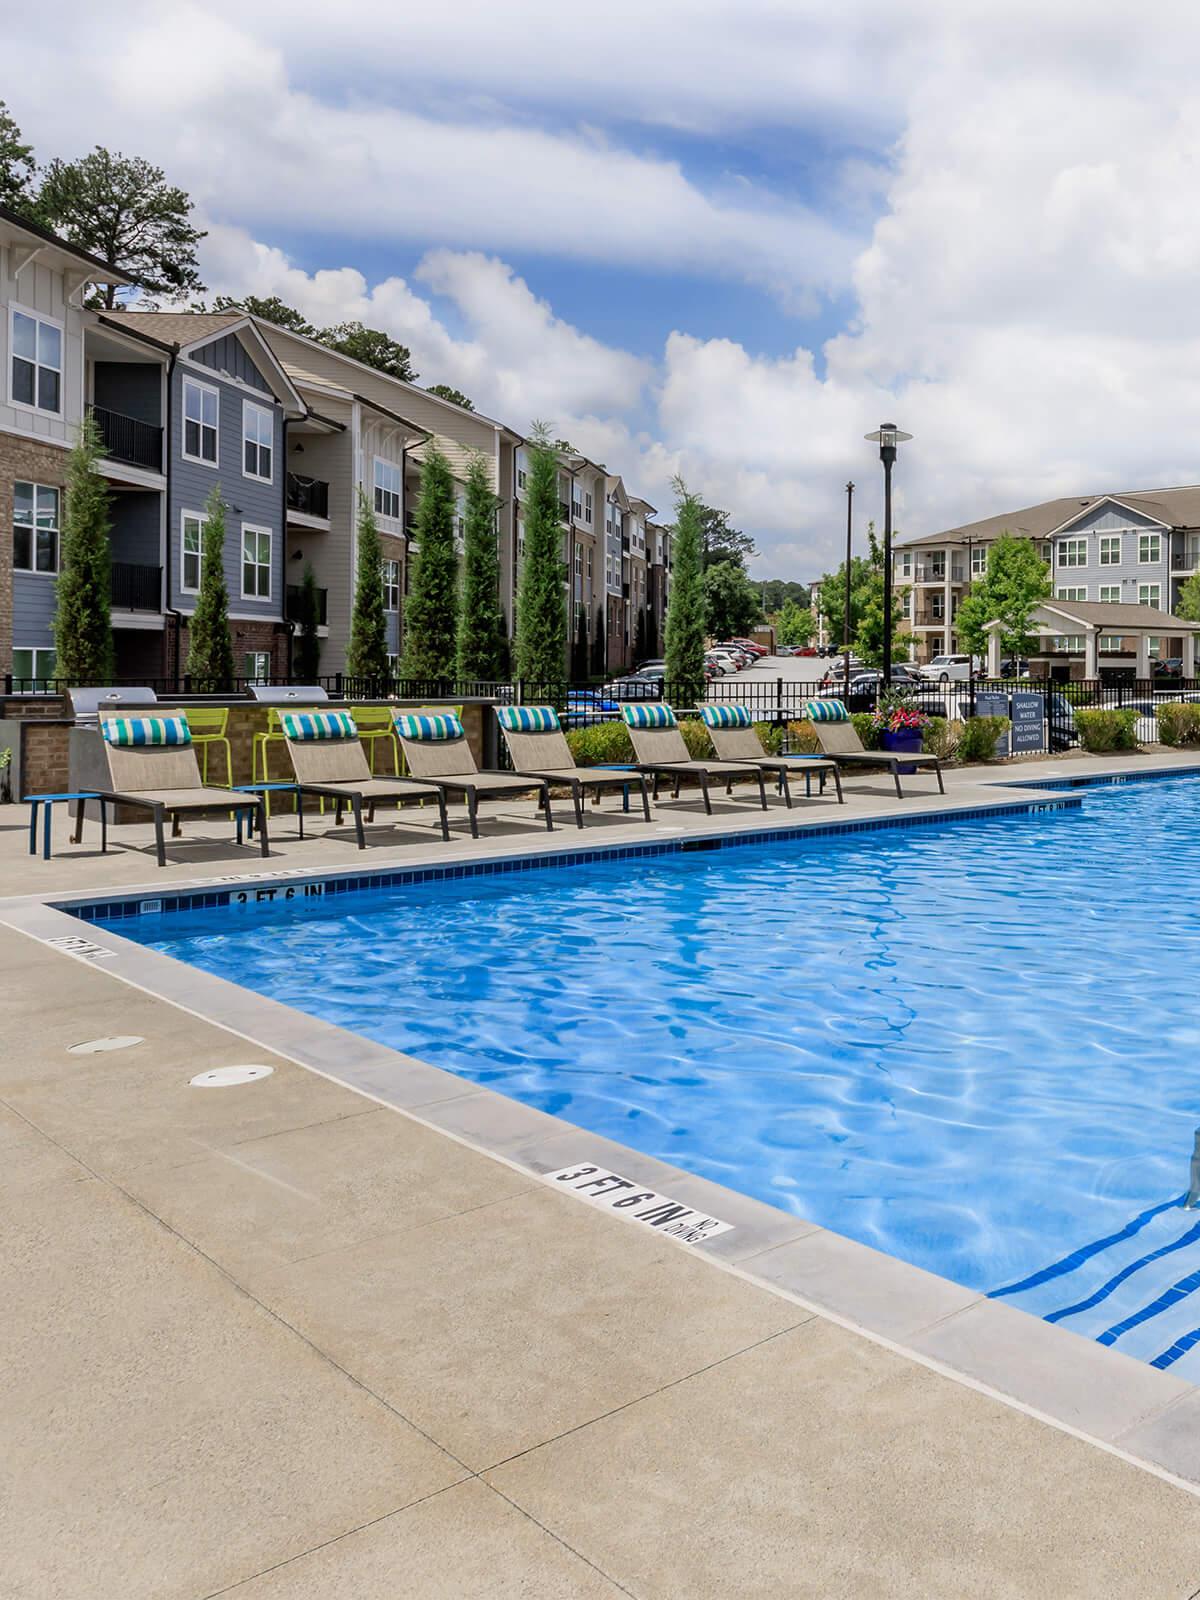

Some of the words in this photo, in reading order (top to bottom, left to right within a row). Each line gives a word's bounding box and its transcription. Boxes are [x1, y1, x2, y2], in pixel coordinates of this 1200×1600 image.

[1016, 701, 1039, 710] SHALLOW
[1020, 711, 1036, 719] WATER
[1014, 725, 1023, 733] NO
[1024, 723, 1041, 732] DIVING
[1016, 734, 1039, 742] ALLOWED
[256, 889, 277, 902] FT
[305, 884, 323, 896] IN
[556, 1167, 598, 1182] 3
[575, 1175, 635, 1197] FT
[612, 1192, 655, 1208] 6
[634, 1202, 695, 1227] IN
[694, 1217, 720, 1231] NO
[663, 1222, 708, 1243] DIVING
